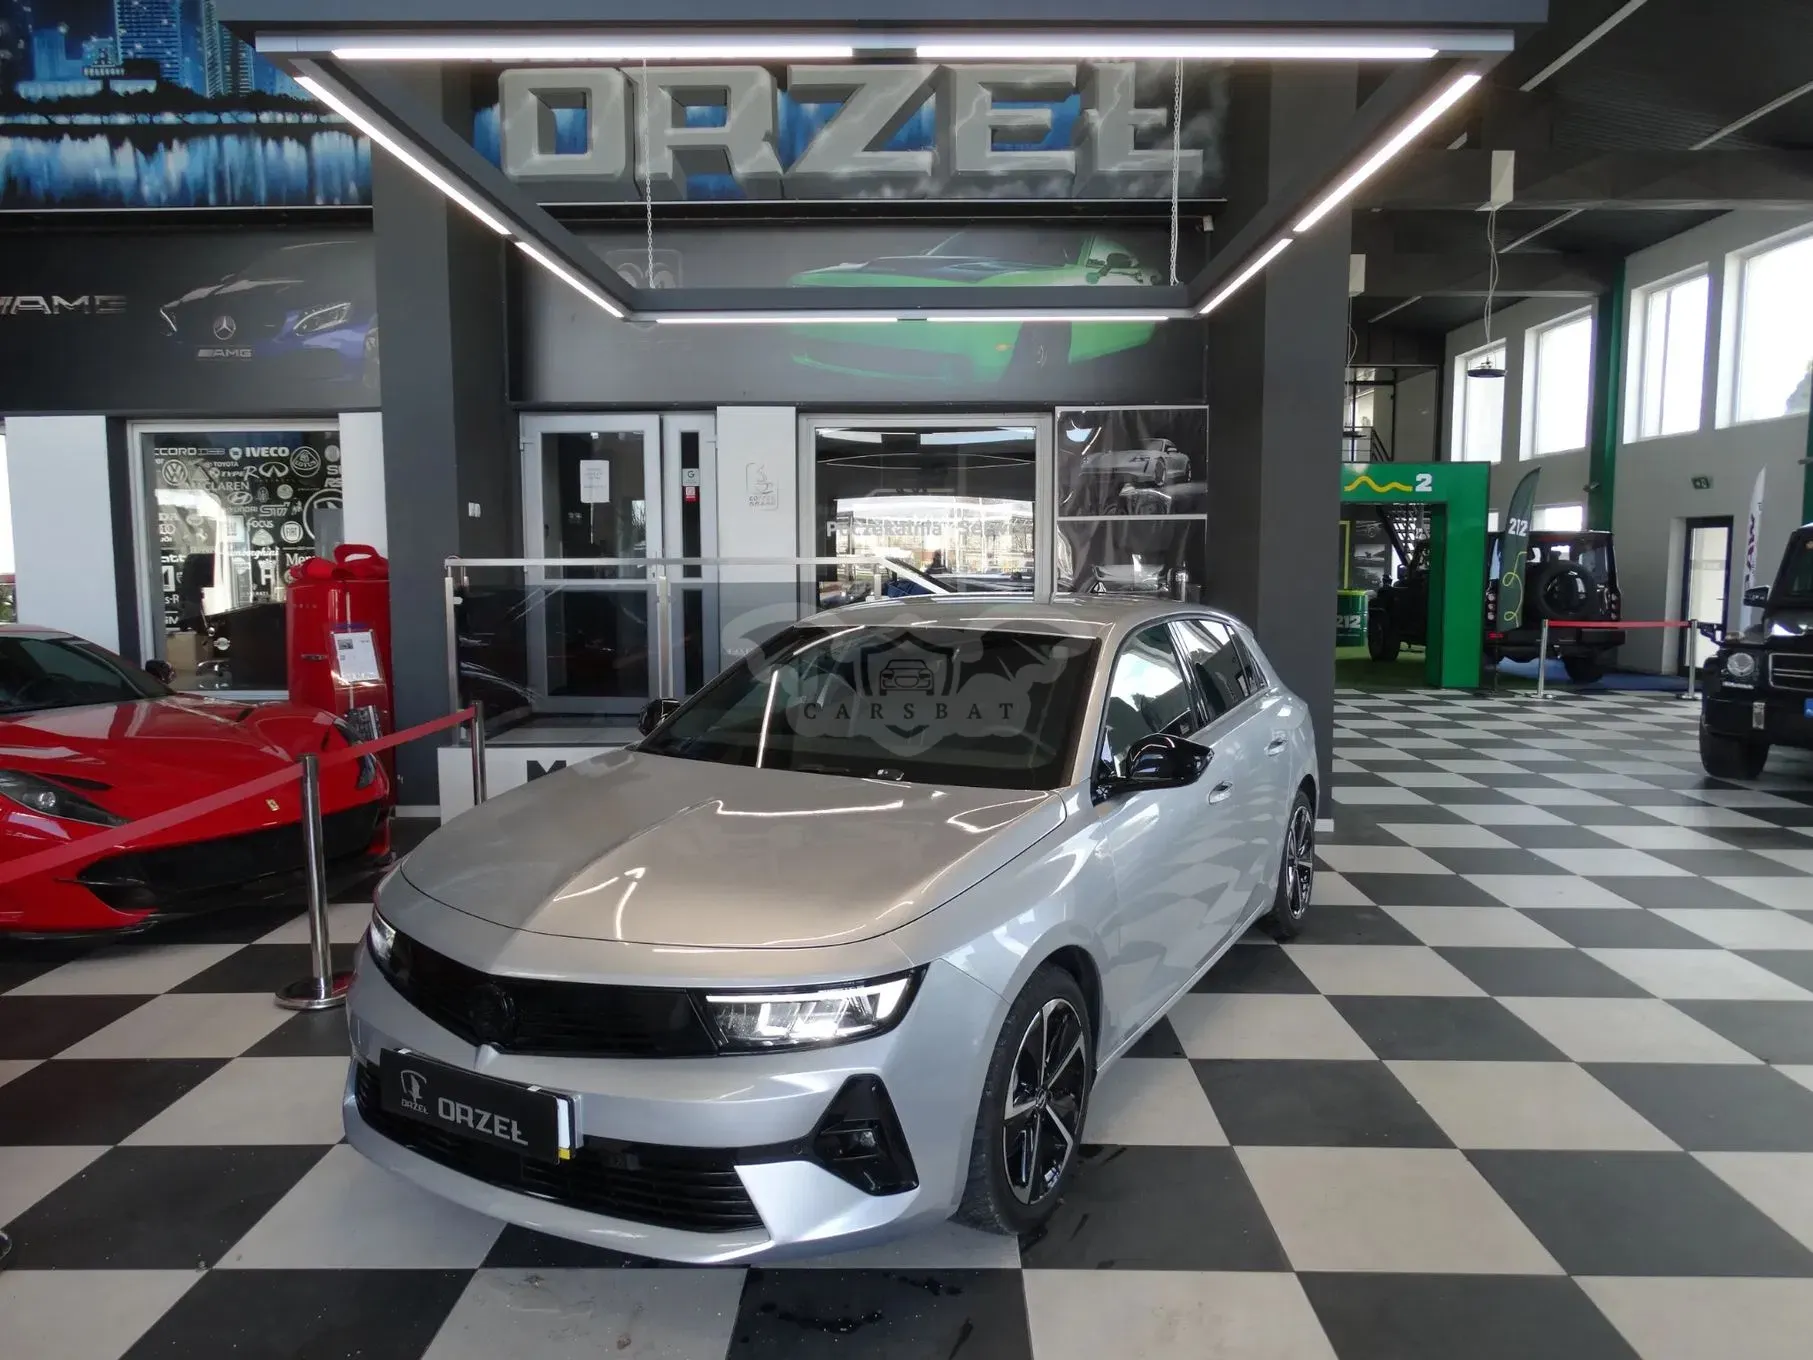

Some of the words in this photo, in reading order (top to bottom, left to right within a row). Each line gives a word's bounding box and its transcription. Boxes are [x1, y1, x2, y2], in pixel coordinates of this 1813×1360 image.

[213, 348, 253, 358] AMG
[245, 446, 290, 457] IVECO
[1415, 473, 1433, 492] 2
[1508, 518, 1529, 537] 212
[438, 1096, 529, 1147] ORZEŁ
